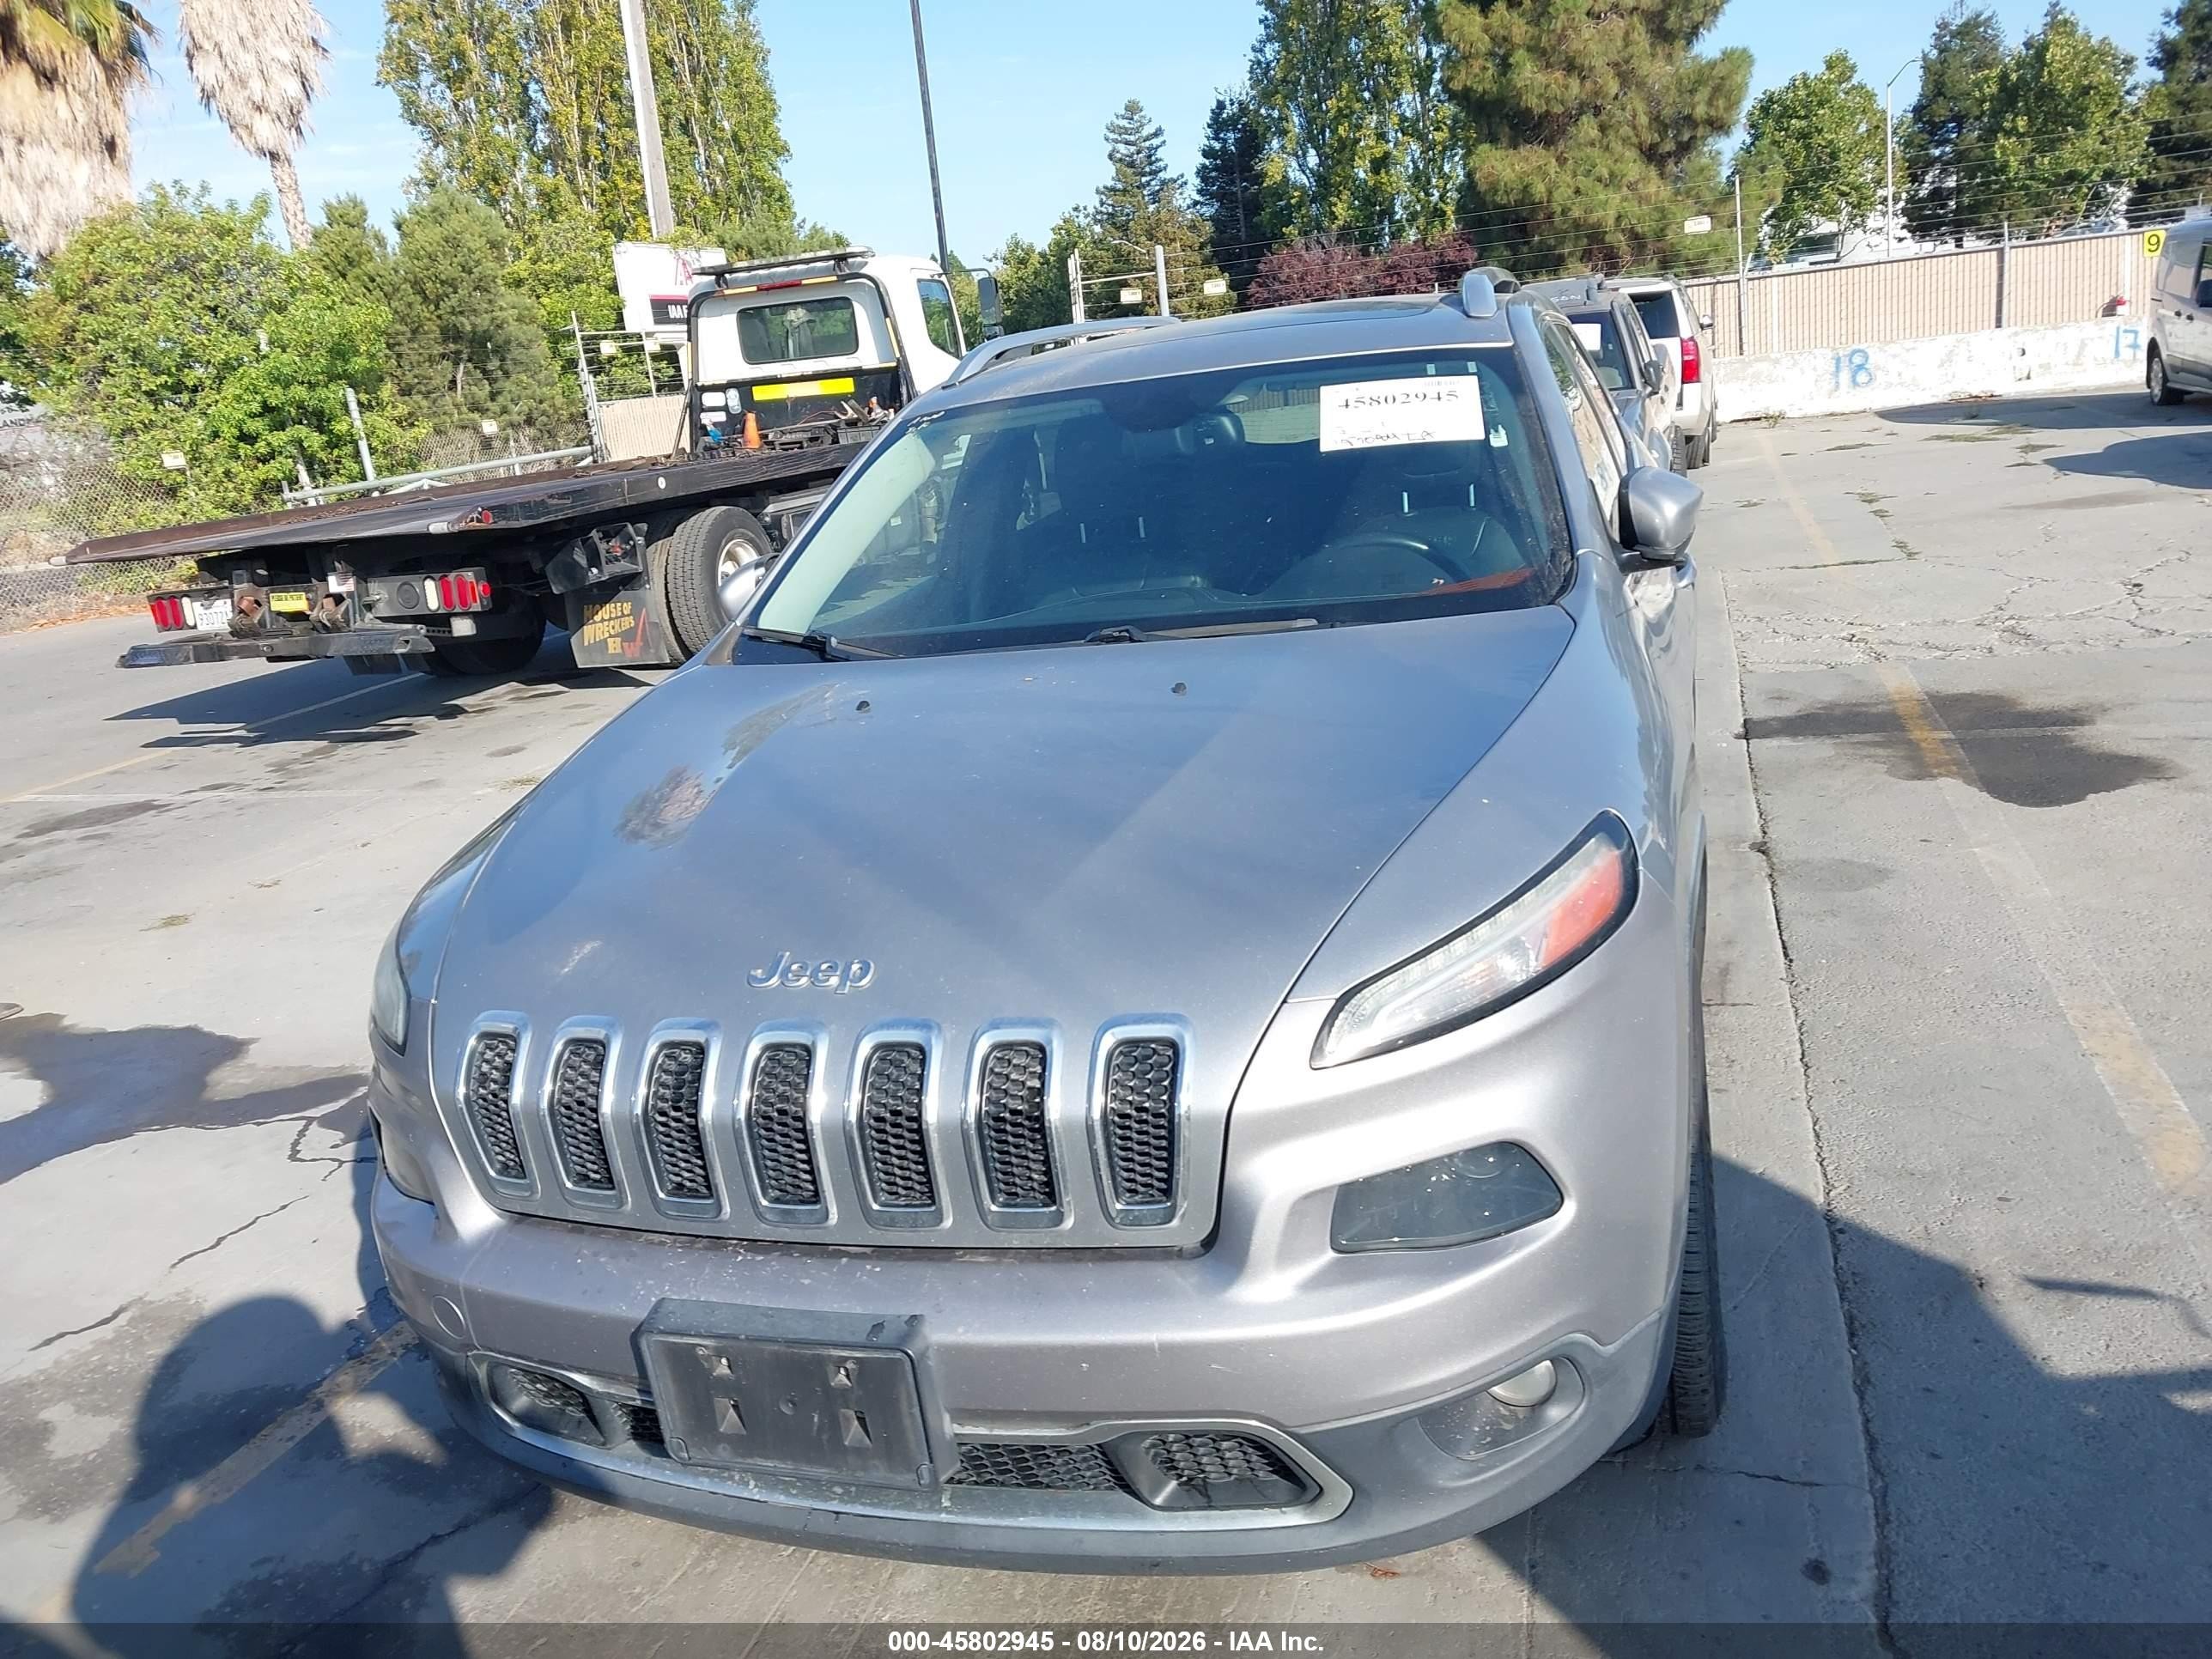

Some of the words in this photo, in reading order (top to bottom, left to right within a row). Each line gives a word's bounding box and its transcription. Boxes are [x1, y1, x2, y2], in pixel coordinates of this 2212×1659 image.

[2148, 234, 2161, 252] 9
[2113, 325, 2142, 360] 17
[1832, 348, 1875, 392] 18
[1338, 390, 1459, 410] 45802945
[584, 603, 622, 622] HOUSE
[622, 601, 633, 616] OF
[583, 616, 635, 647] WRECKERS
[746, 951, 876, 995] Jeep
